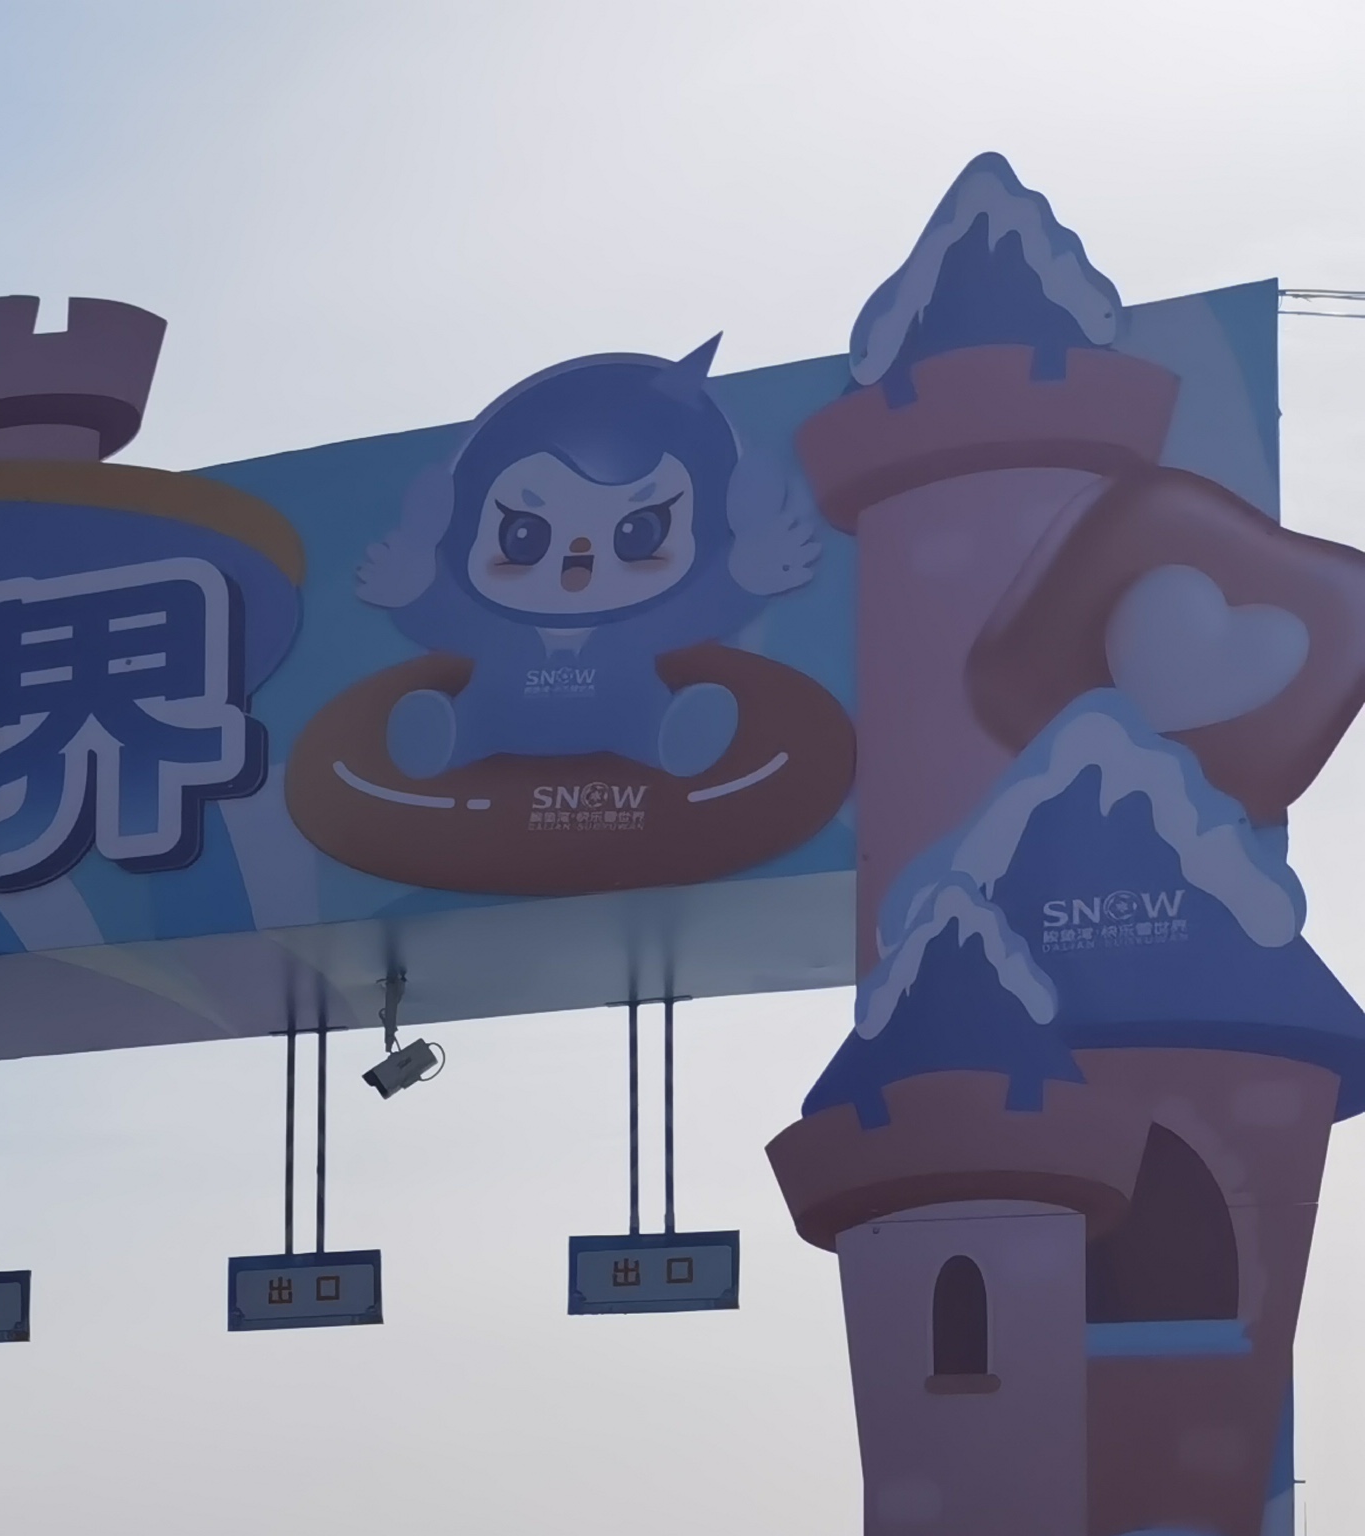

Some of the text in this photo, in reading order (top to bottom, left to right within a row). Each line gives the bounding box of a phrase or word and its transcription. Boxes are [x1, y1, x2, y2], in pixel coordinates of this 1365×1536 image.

[525, 667, 596, 686] SNOW
[532, 782, 648, 809] SNOW
[1043, 889, 1186, 927] SNOW
[612, 1257, 693, 1287] 出口
[268, 1274, 340, 1305] 出口
